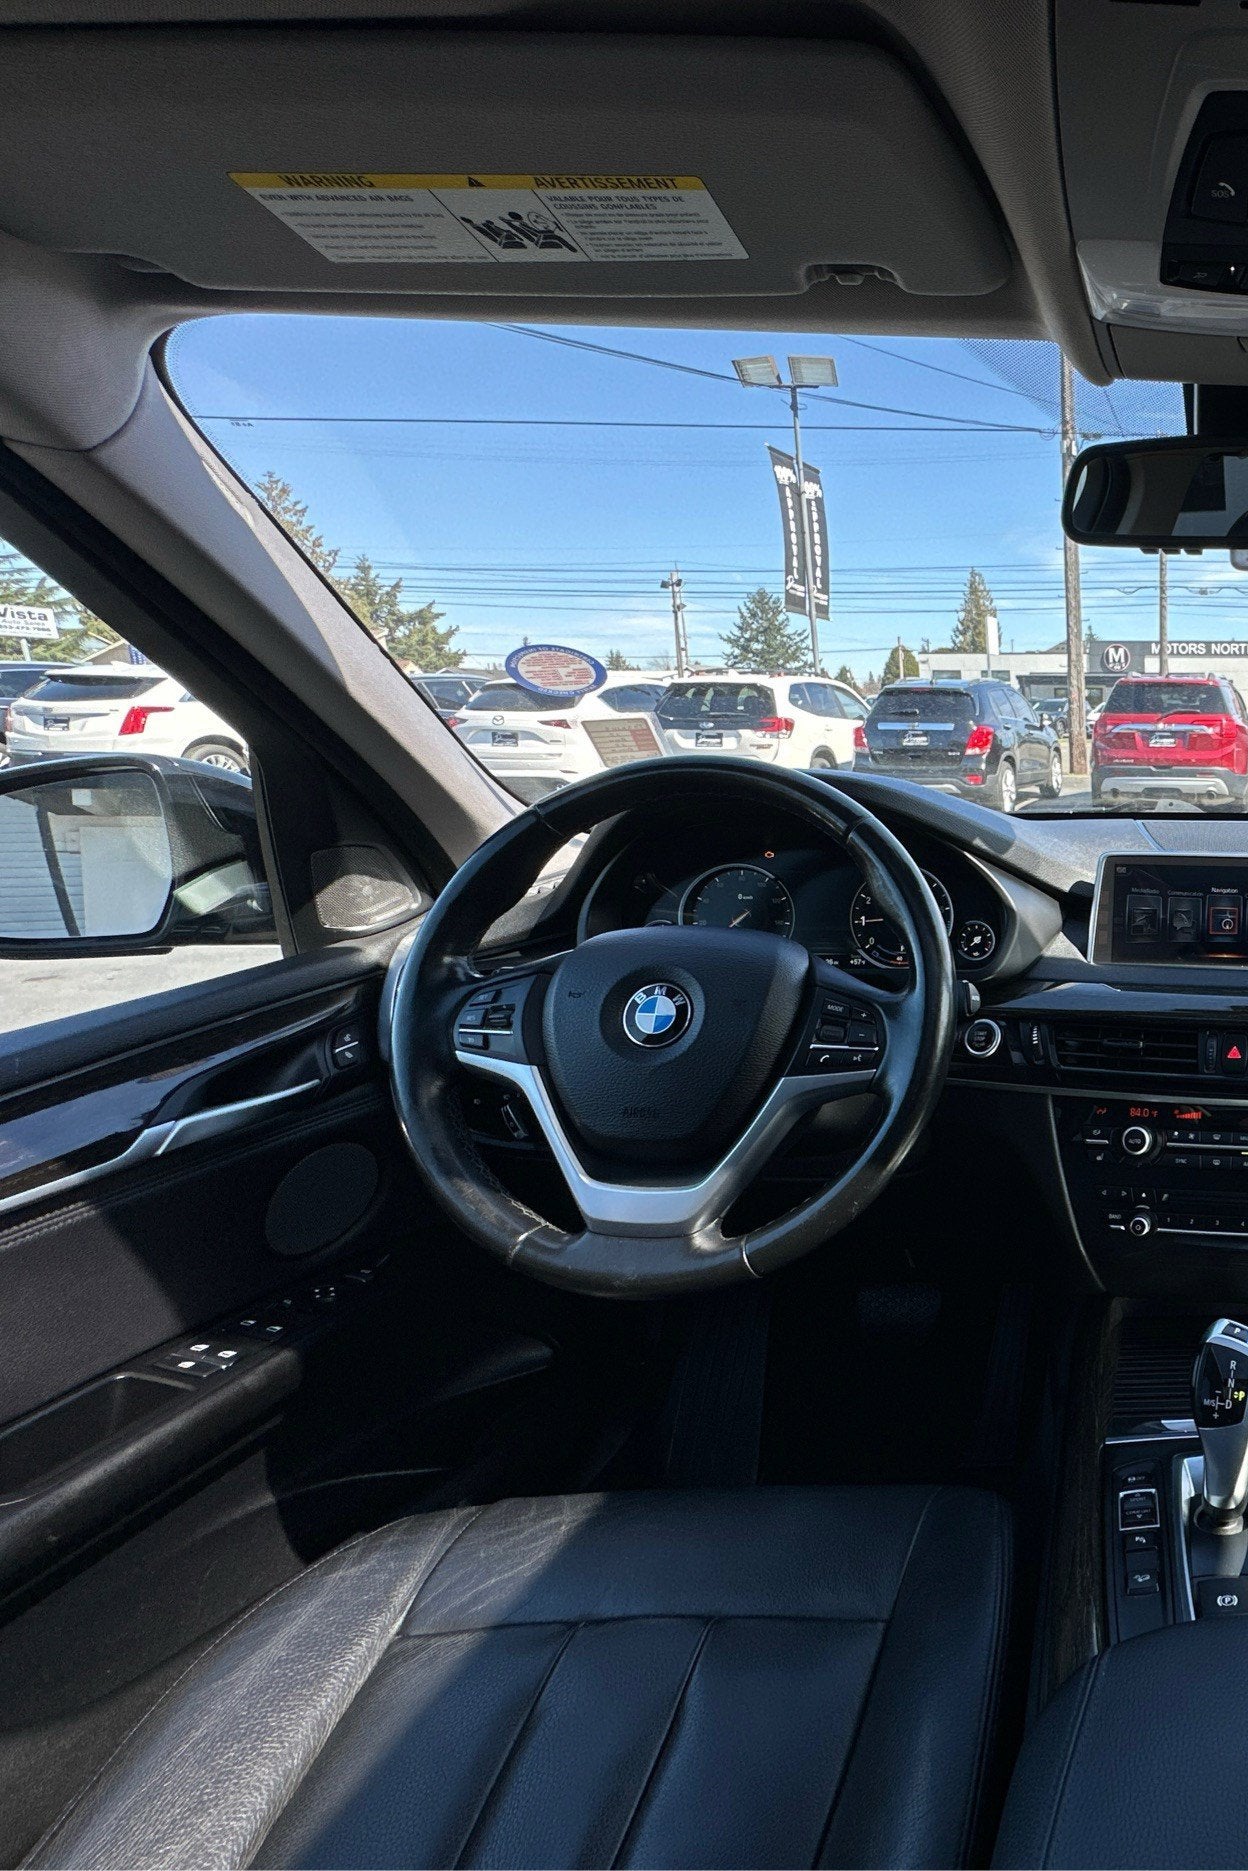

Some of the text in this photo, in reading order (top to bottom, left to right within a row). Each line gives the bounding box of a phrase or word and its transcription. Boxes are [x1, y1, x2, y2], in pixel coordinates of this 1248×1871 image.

[278, 175, 376, 188] WARNING
[533, 177, 679, 189] AVERTISSEMENT
[1211, 887, 1239, 895] Navigation
[866, 897, 871, 905] 2
[860, 916, 866, 926] 1
[869, 937, 875, 945] 0
[634, 985, 686, 1006] BMW
[1128, 1106, 1150, 1118] 84.0
[1229, 1360, 1236, 1370] R
[1227, 1378, 1235, 1388] N
[1238, 1391, 1245, 1401] P
[1225, 1399, 1232, 1409] D
